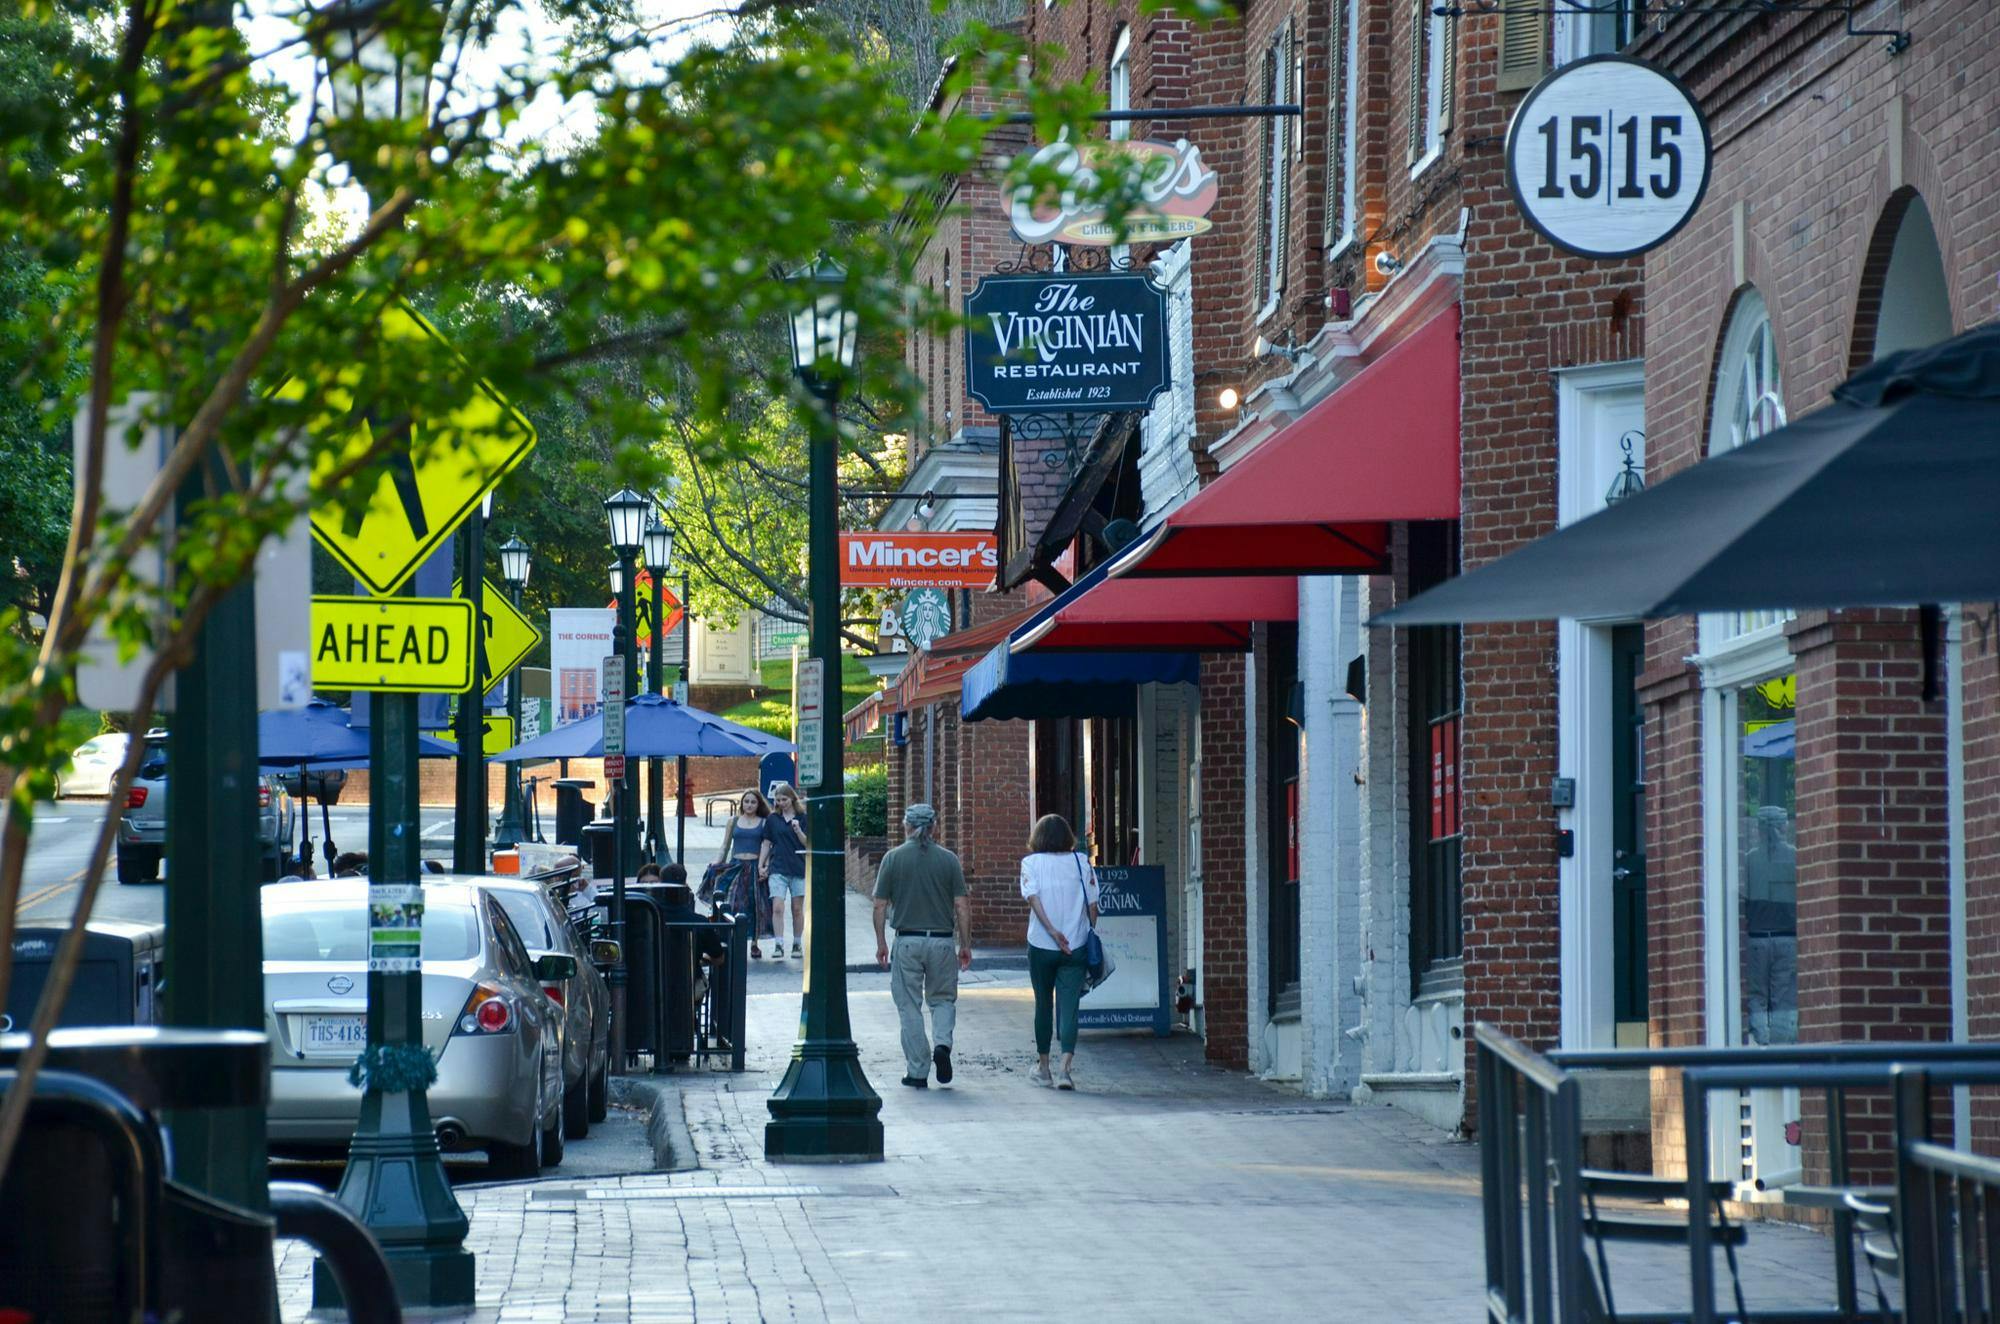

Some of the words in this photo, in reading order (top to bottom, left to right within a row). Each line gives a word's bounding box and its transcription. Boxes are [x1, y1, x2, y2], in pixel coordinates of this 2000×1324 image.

[1034, 284, 1095, 312] The
[988, 309, 1144, 362] VIRGINIAN
[994, 361, 1141, 378] RESTAURANT
[1025, 387, 1082, 401] Established
[1087, 386, 1111, 399] 1923
[848, 540, 998, 566] Mincer's
[896, 567, 923, 575] Virginia
[890, 577, 962, 587] Mincers.com
[317, 622, 449, 664] AHEAD
[575, 633, 610, 641] CORNER
[1107, 870, 1129, 880] 1923
